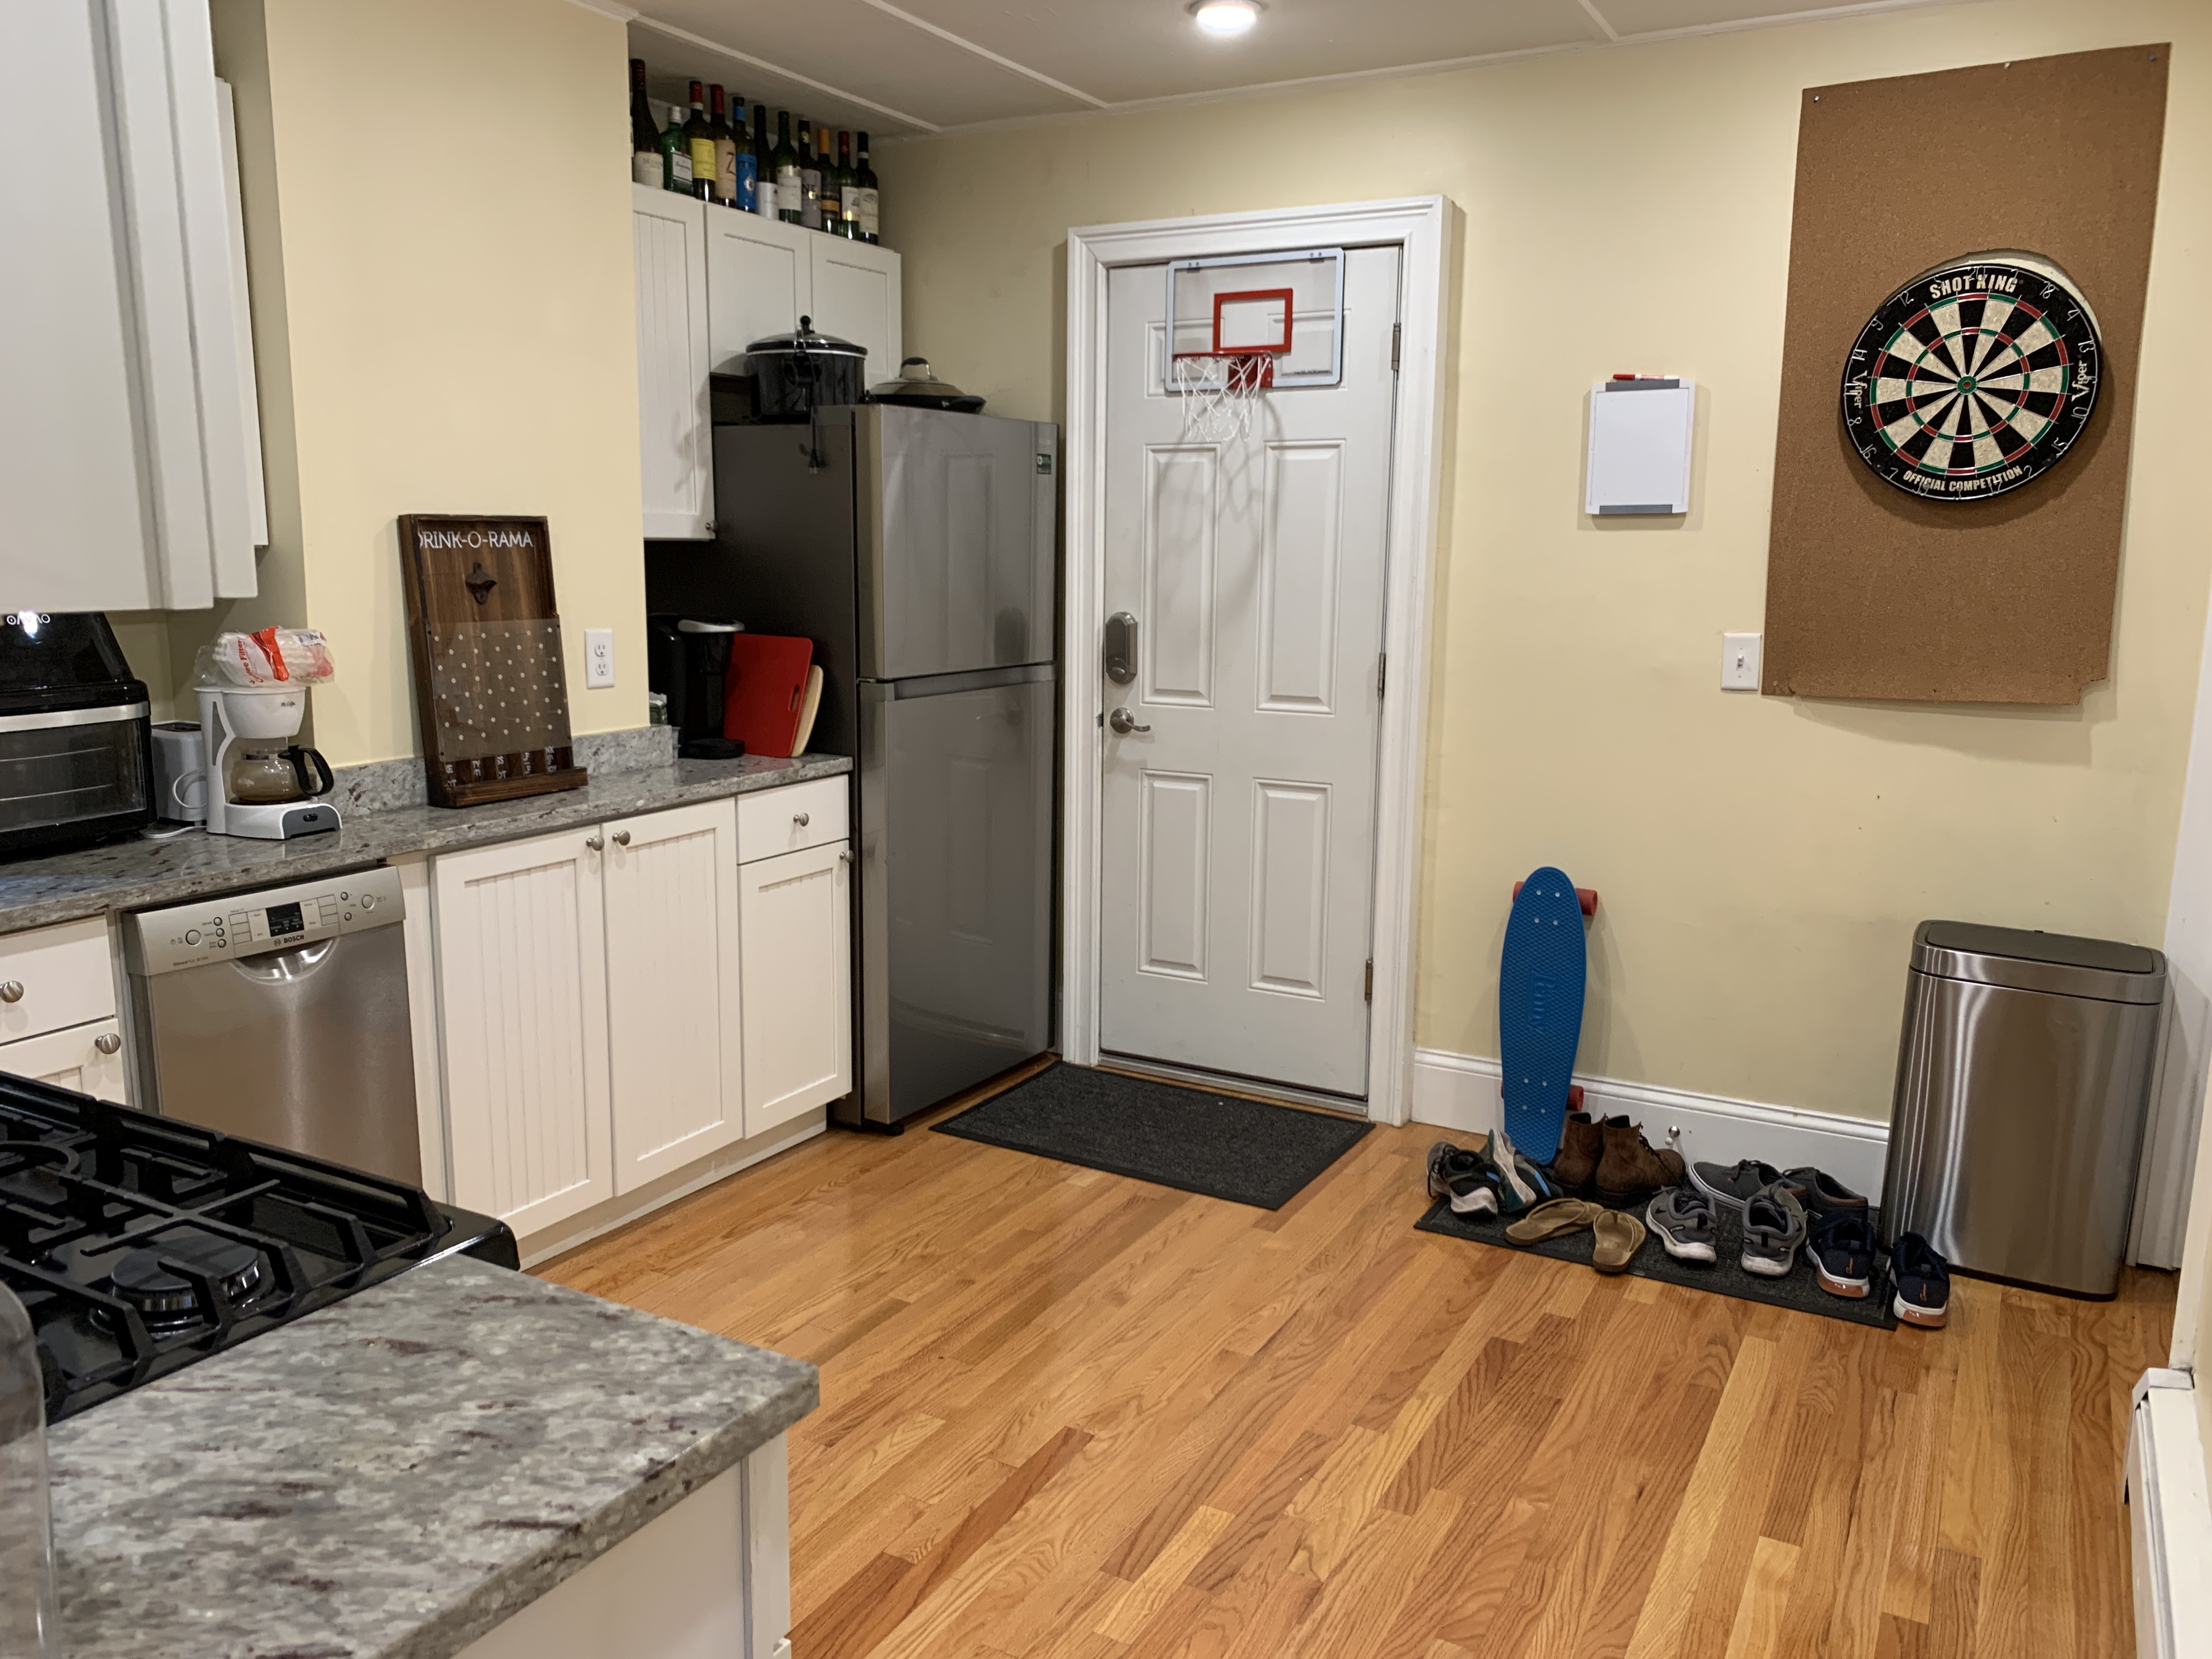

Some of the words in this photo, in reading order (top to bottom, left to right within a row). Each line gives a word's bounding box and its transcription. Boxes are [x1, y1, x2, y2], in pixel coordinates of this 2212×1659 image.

[1929, 275, 1970, 299] SHOT
[1976, 274, 2018, 293] KING
[1849, 370, 1867, 409] Viper
[2071, 360, 2092, 402] Viper
[1903, 470, 1946, 492] OFFICIAL
[1949, 467, 2023, 492] COMPETITION
[284, 934, 305, 944] BOSCH
